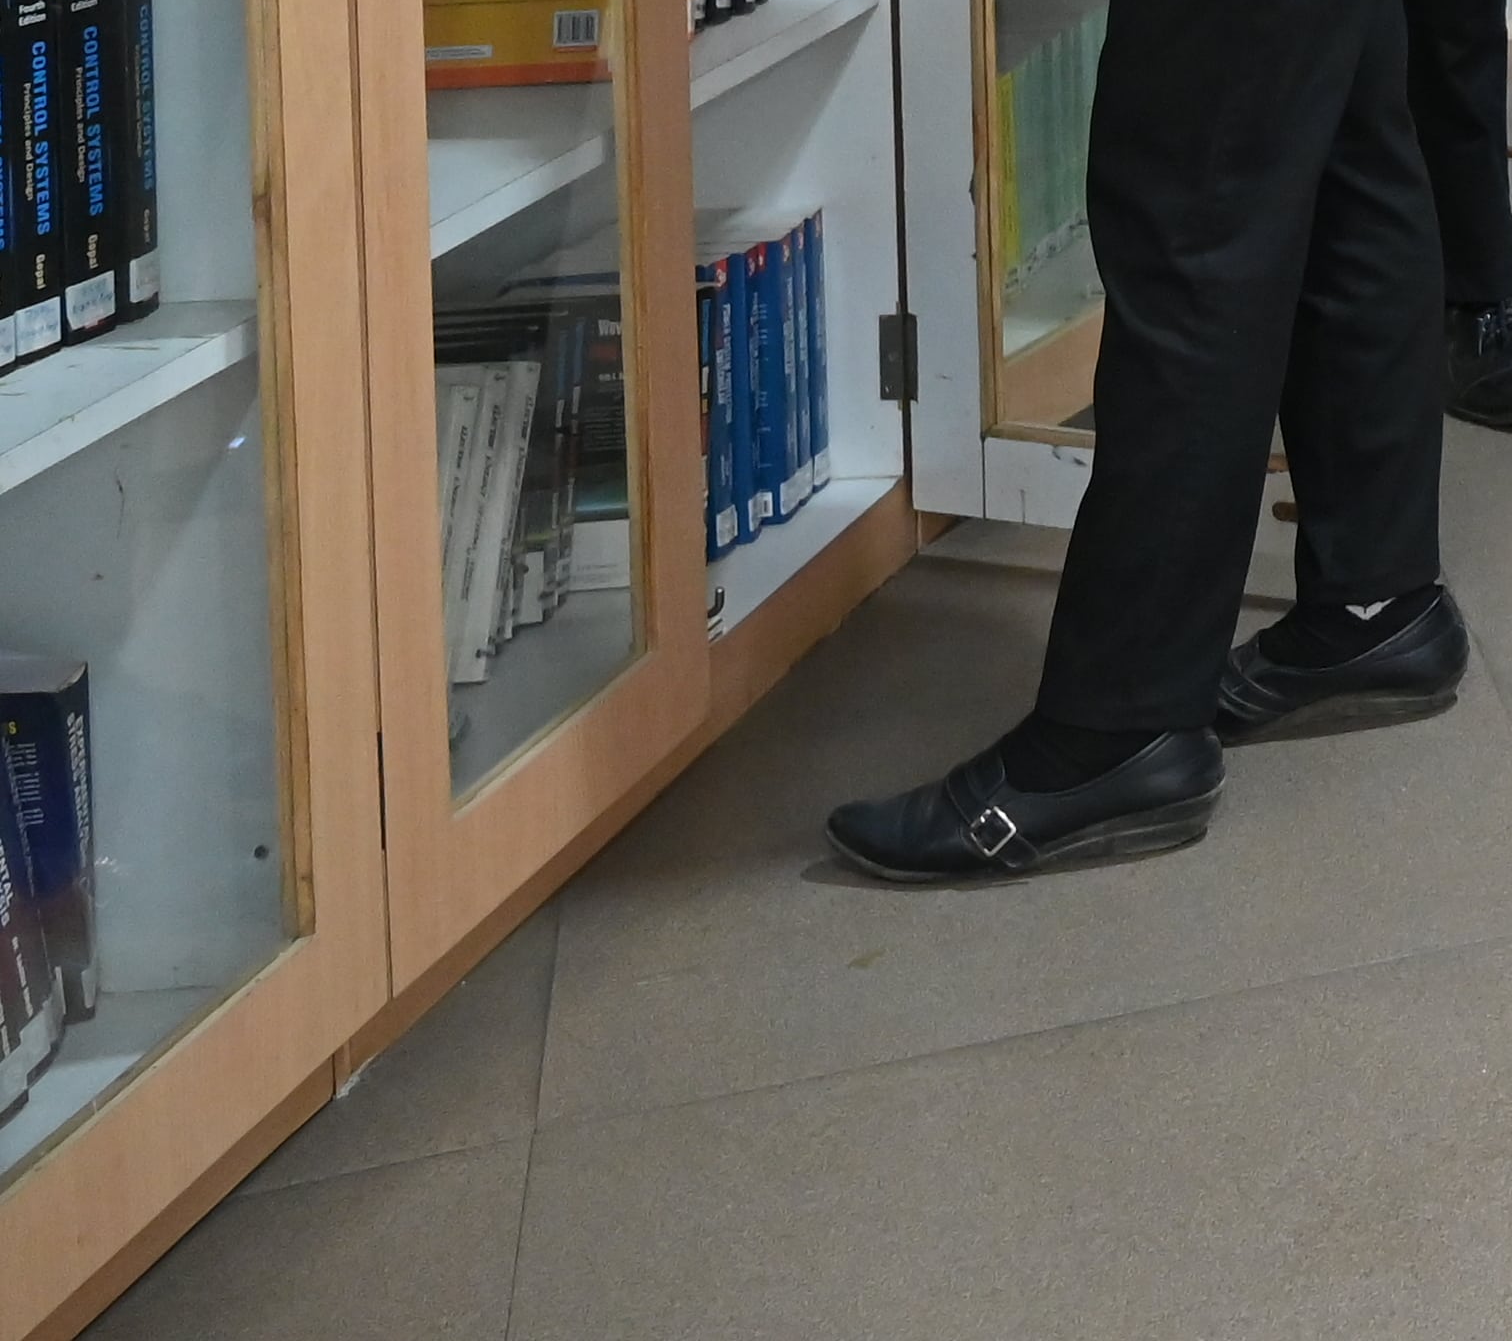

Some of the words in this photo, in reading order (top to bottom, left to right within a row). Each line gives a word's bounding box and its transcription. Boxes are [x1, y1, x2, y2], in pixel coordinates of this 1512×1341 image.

[82, 25, 100, 120] CONTROL
[140, 4, 151, 98] CONTROL
[23, 82, 33, 139] Principles
[31, 40, 49, 136] CONTROL
[75, 66, 86, 121] Principles
[24, 139, 33, 160] and
[76, 122, 86, 144] and
[141, 101, 154, 192] SYSTEMS
[25, 161, 35, 202] Design
[34, 141, 51, 236] SYSTEMS
[77, 144, 87, 184] Design
[87, 124, 104, 217] SYSTEMS
[35, 252, 46, 290] Gopal
[86, 233, 98, 269] Gopal
